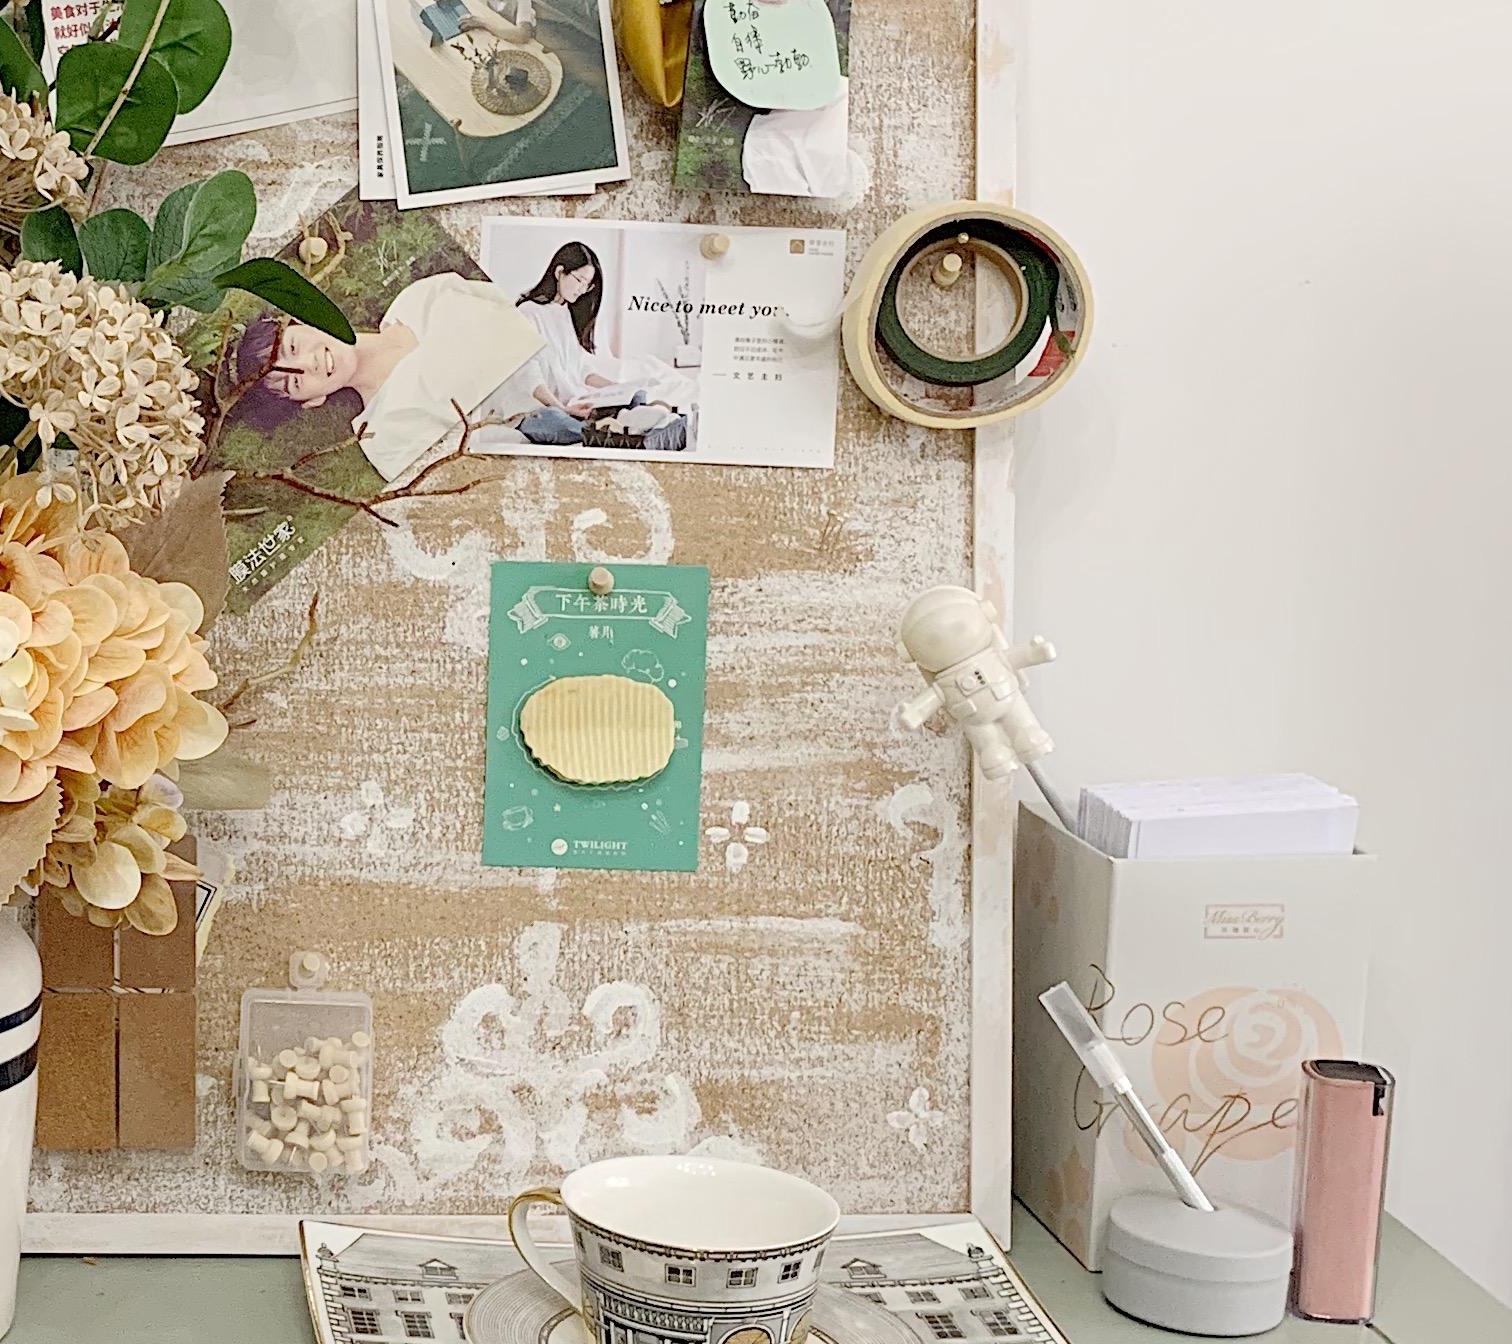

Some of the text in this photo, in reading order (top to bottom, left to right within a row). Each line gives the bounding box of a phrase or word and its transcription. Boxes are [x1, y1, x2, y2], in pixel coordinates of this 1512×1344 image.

[628, 295, 670, 313] Nice
[675, 299, 694, 314] to
[699, 301, 745, 316] meet
[229, 520, 296, 585] 膜法世家
[555, 593, 649, 614] 下午茶時光
[572, 839, 628, 851] TWILIGHT
[1086, 964, 1229, 1046] Rose
